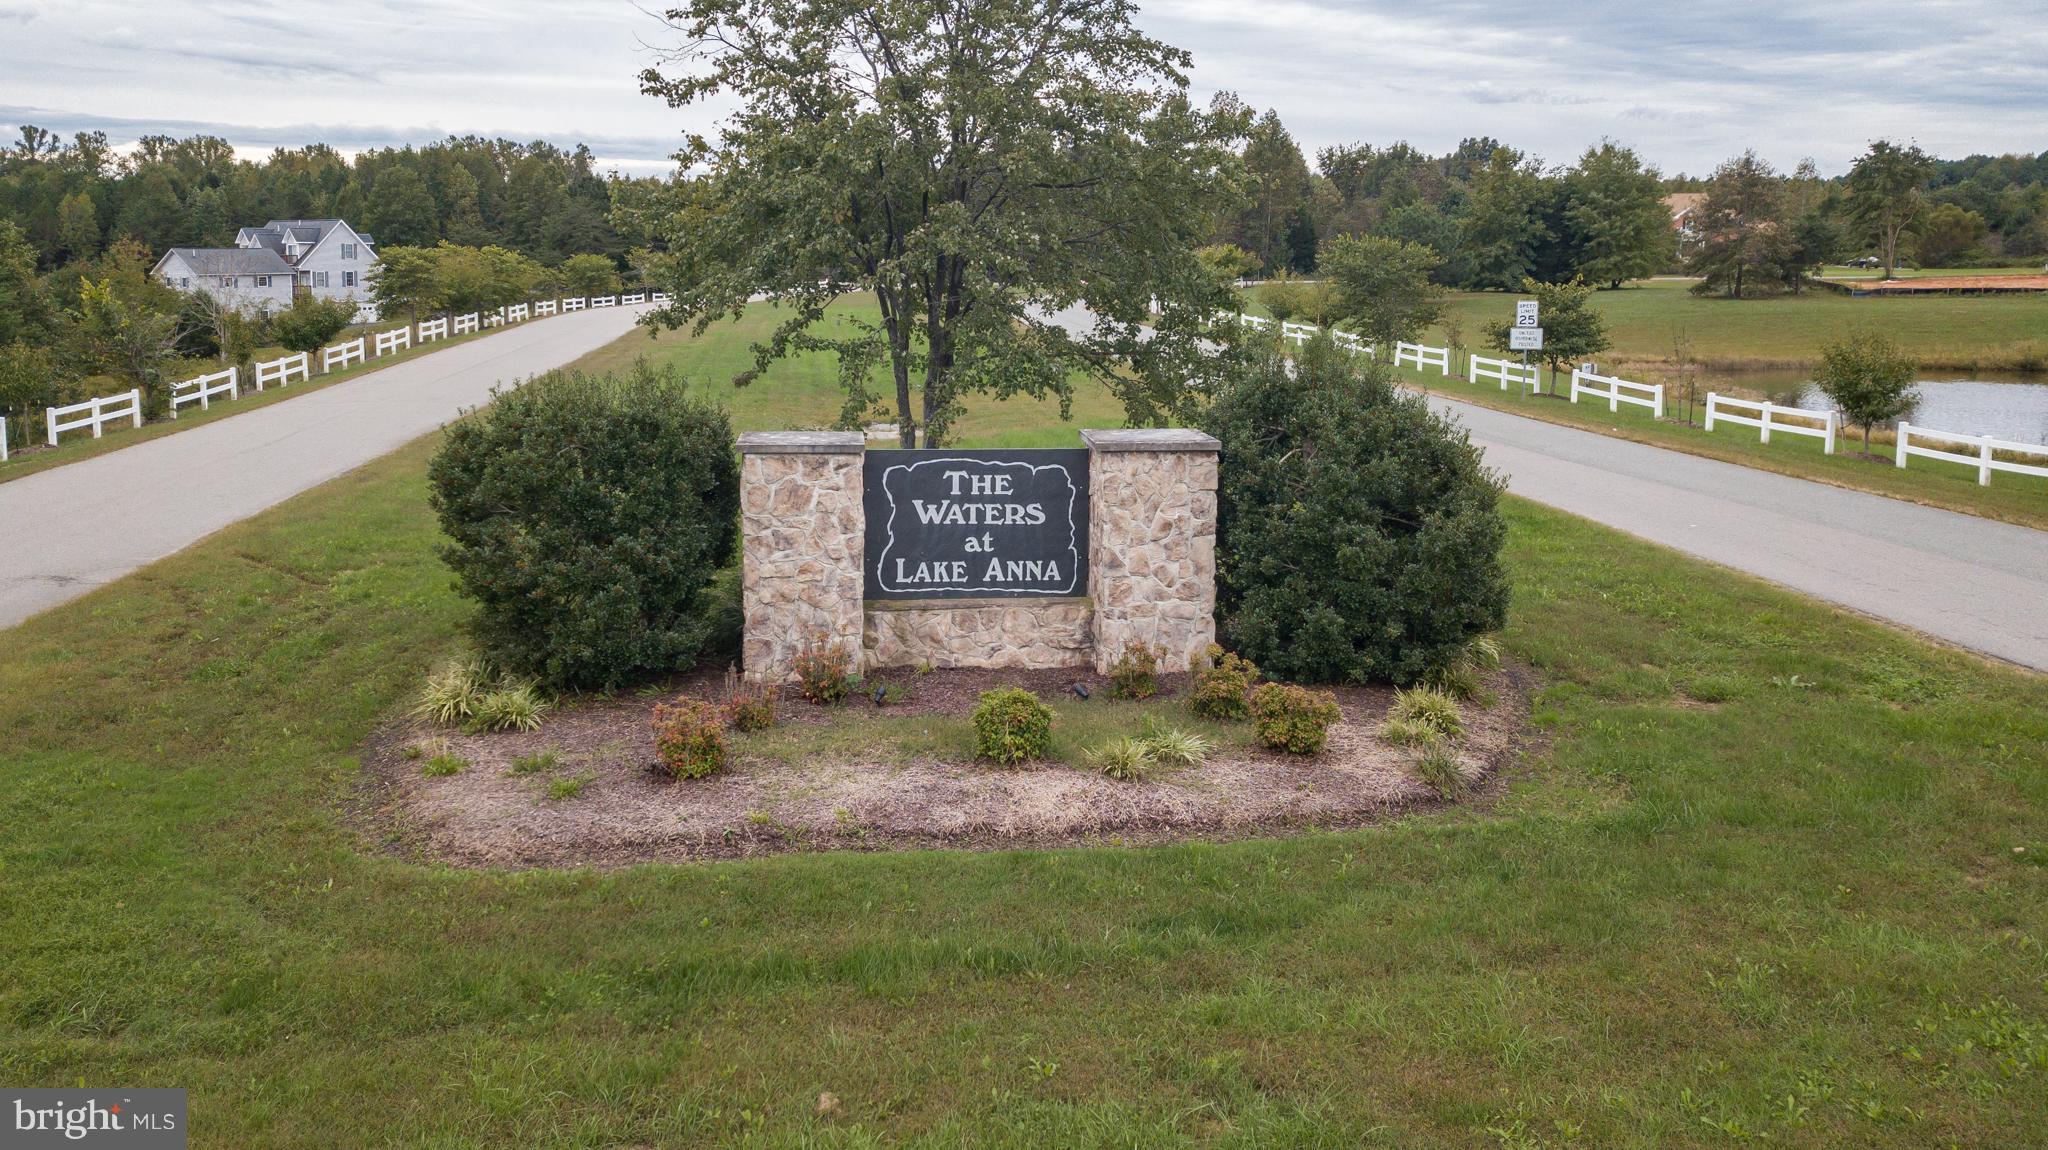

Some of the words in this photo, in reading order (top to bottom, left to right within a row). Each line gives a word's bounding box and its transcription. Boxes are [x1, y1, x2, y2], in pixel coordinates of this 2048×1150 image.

[1519, 315, 1536, 325] 25
[943, 470, 1013, 496] THE
[912, 500, 1046, 525] WATERS
[964, 531, 994, 552] at
[895, 558, 968, 583] LAKE
[983, 557, 1061, 581] ANNA
